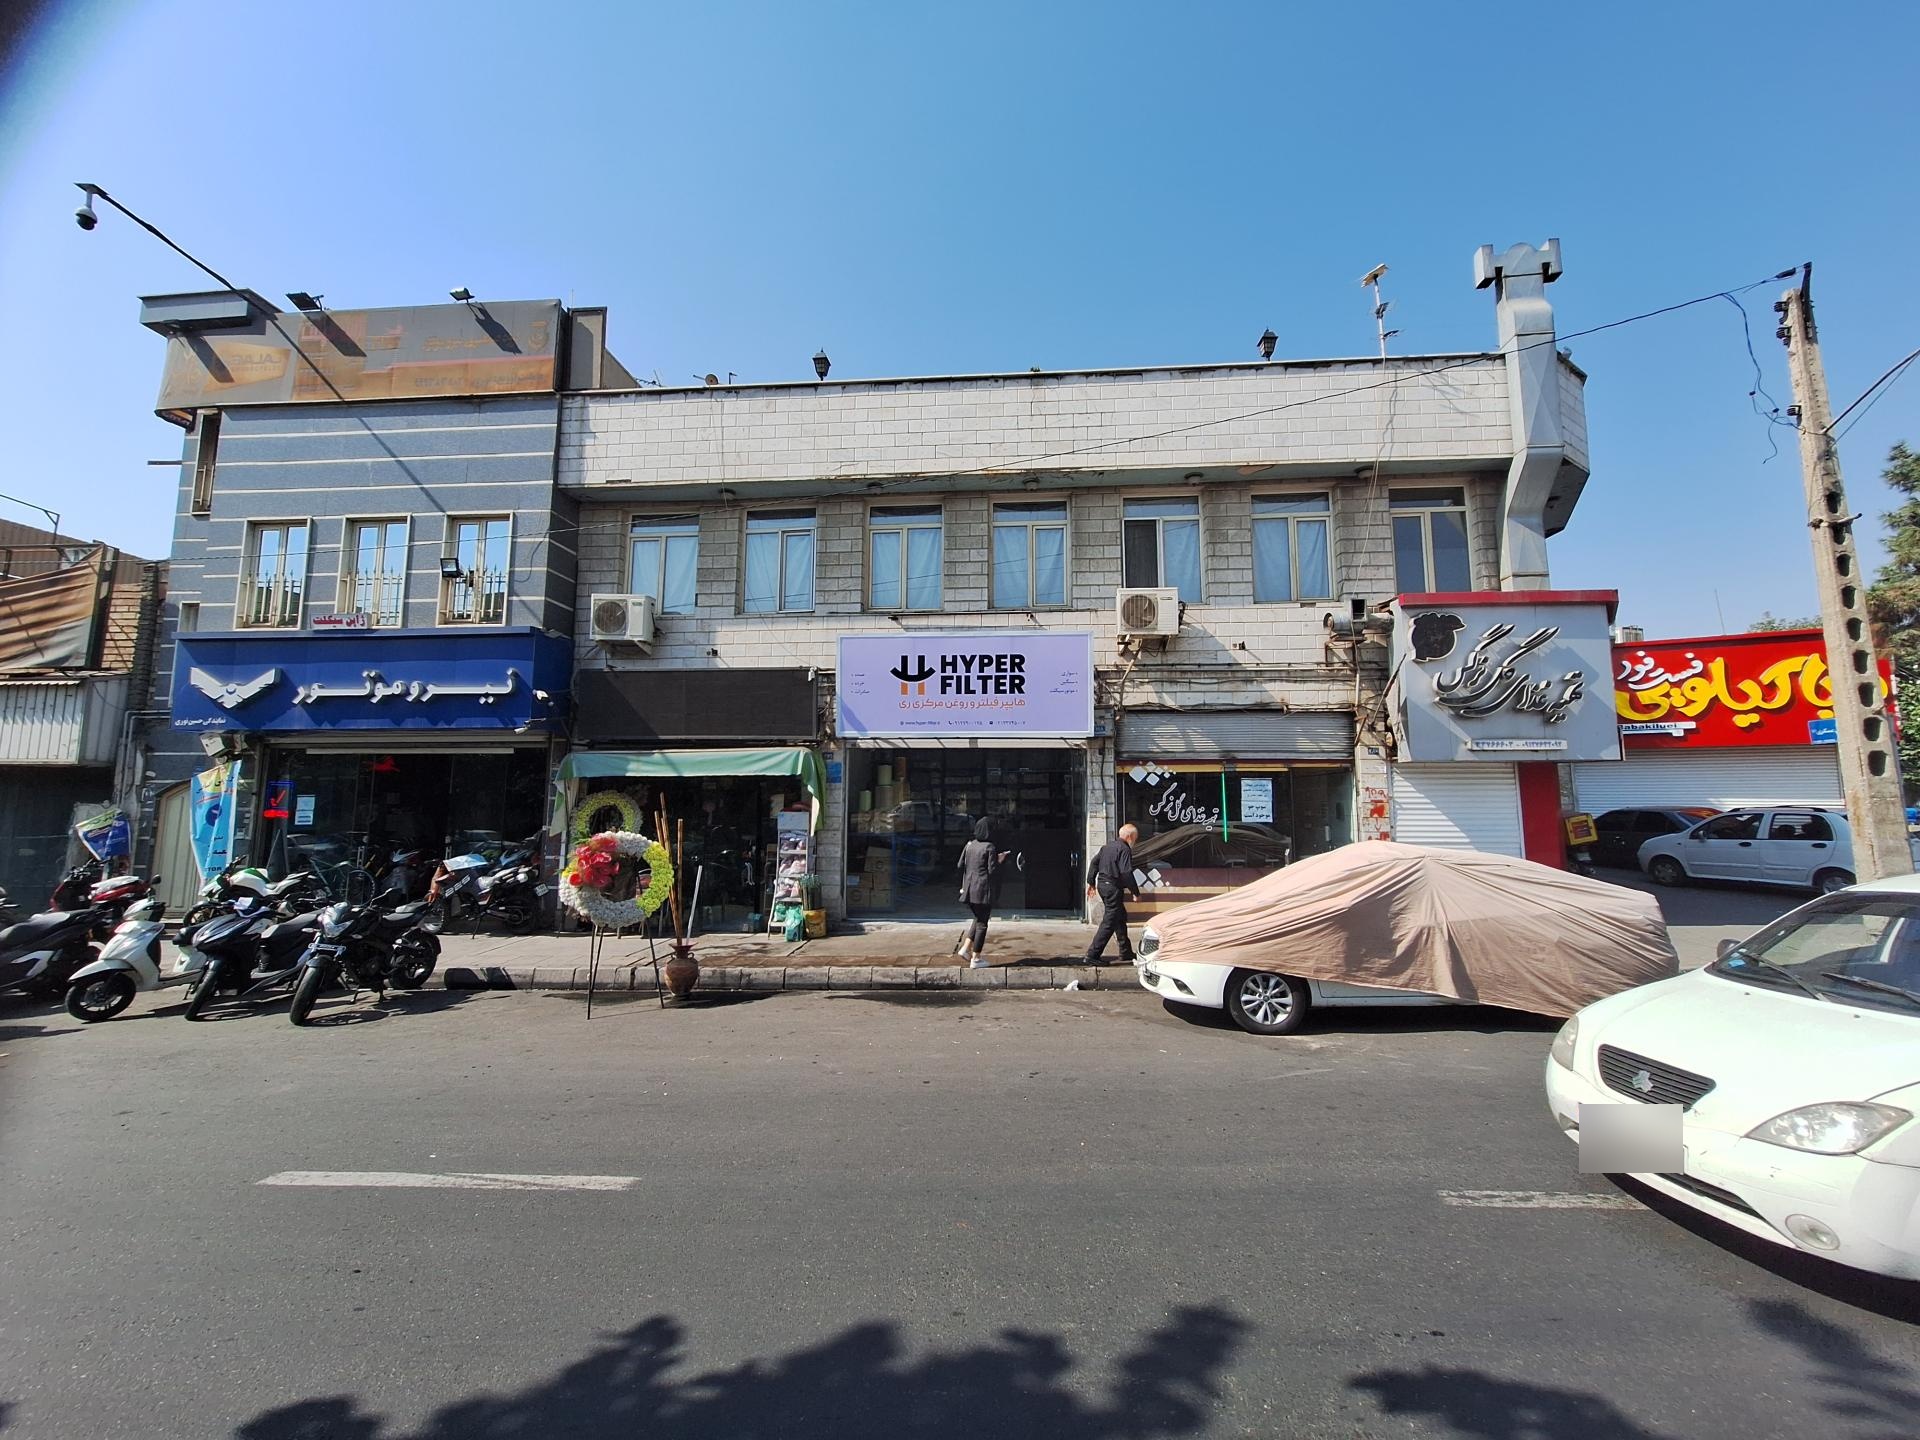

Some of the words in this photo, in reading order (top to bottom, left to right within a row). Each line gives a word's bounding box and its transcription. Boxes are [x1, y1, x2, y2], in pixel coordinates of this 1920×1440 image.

[312, 615, 344, 628] سیکلت
[940, 653, 1026, 674] HYPER
[1617, 650, 1655, 681] فود
[1628, 652, 1704, 690] فست
[940, 674, 1026, 695] FILTER
[898, 699, 911, 710] ری
[912, 698, 944, 710] مرکزی
[944, 697, 969, 710] روغن
[970, 701, 975, 710] و
[976, 696, 999, 711] فیلتر
[1000, 697, 1026, 711] هایپر
[1148, 781, 1178, 816] نرگس
[1202, 807, 1220, 832] تهیه
